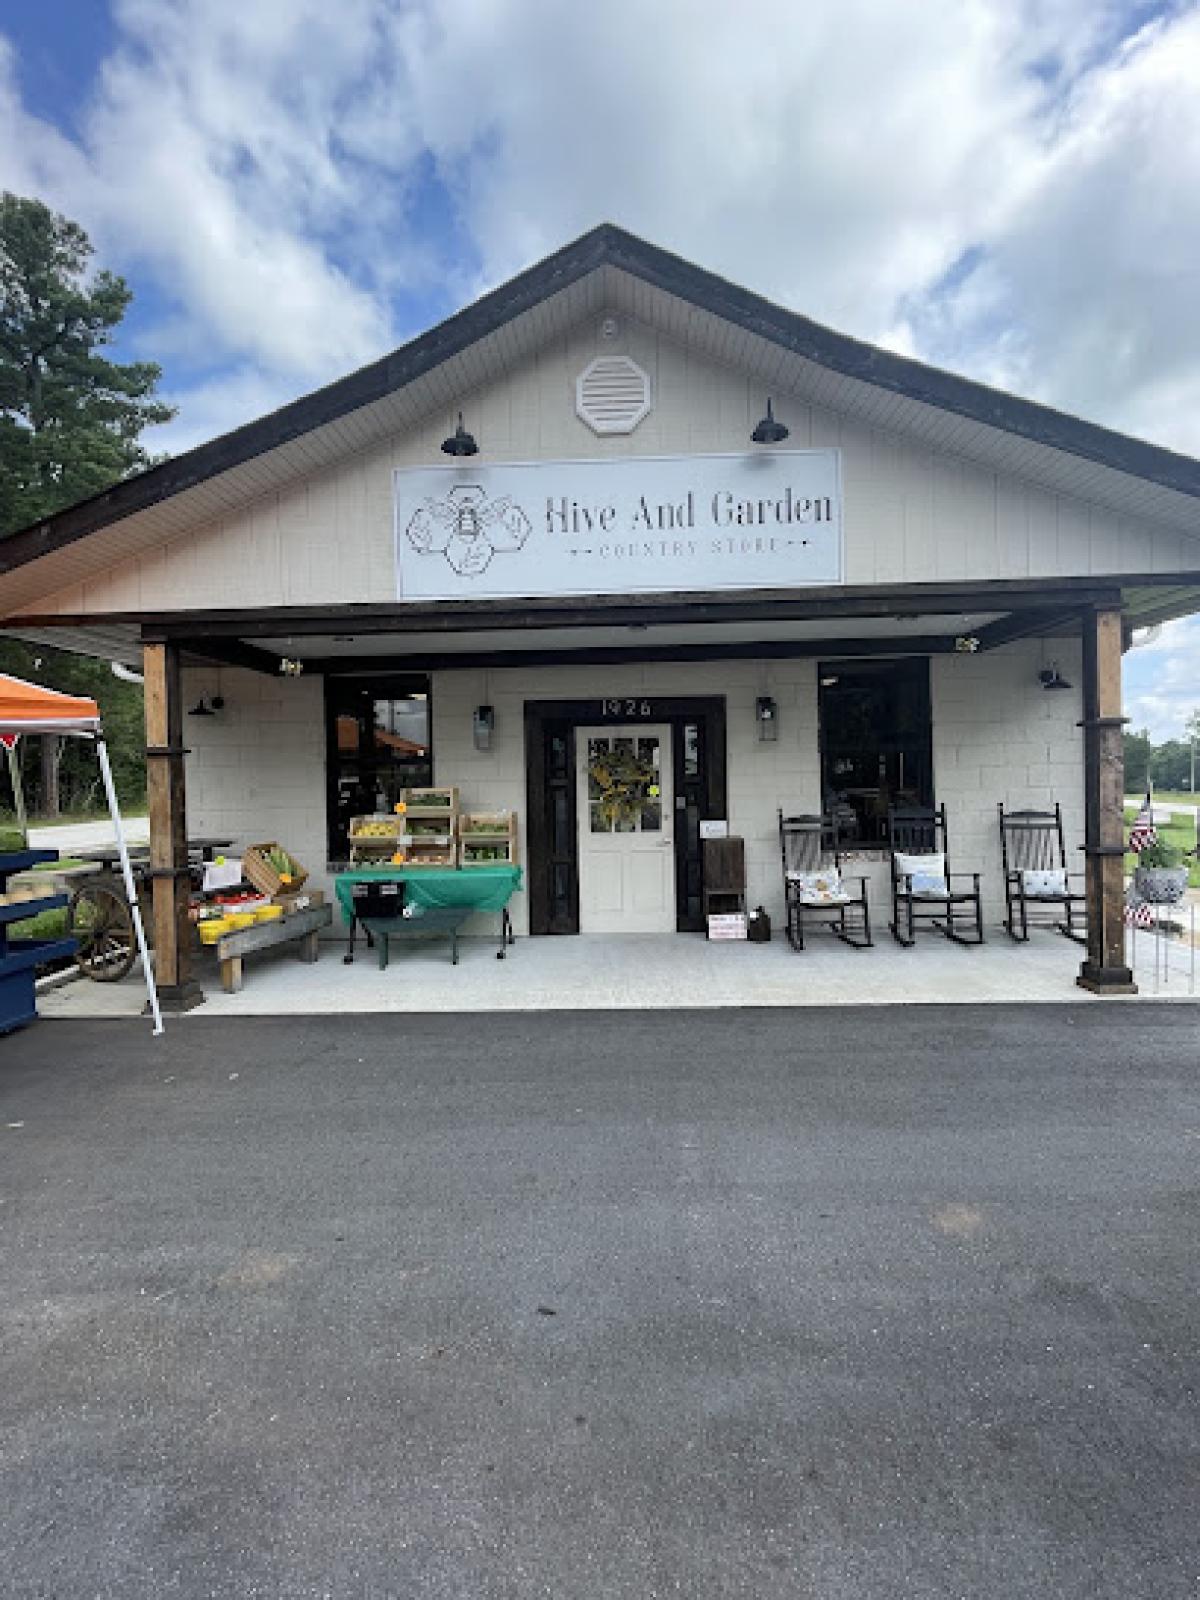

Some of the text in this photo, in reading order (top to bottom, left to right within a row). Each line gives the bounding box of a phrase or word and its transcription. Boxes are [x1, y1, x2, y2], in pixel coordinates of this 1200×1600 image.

[546, 487, 833, 533] Hive And Garden
[599, 537, 778, 559] COUNTRY STORE
[602, 699, 651, 716] 1926
